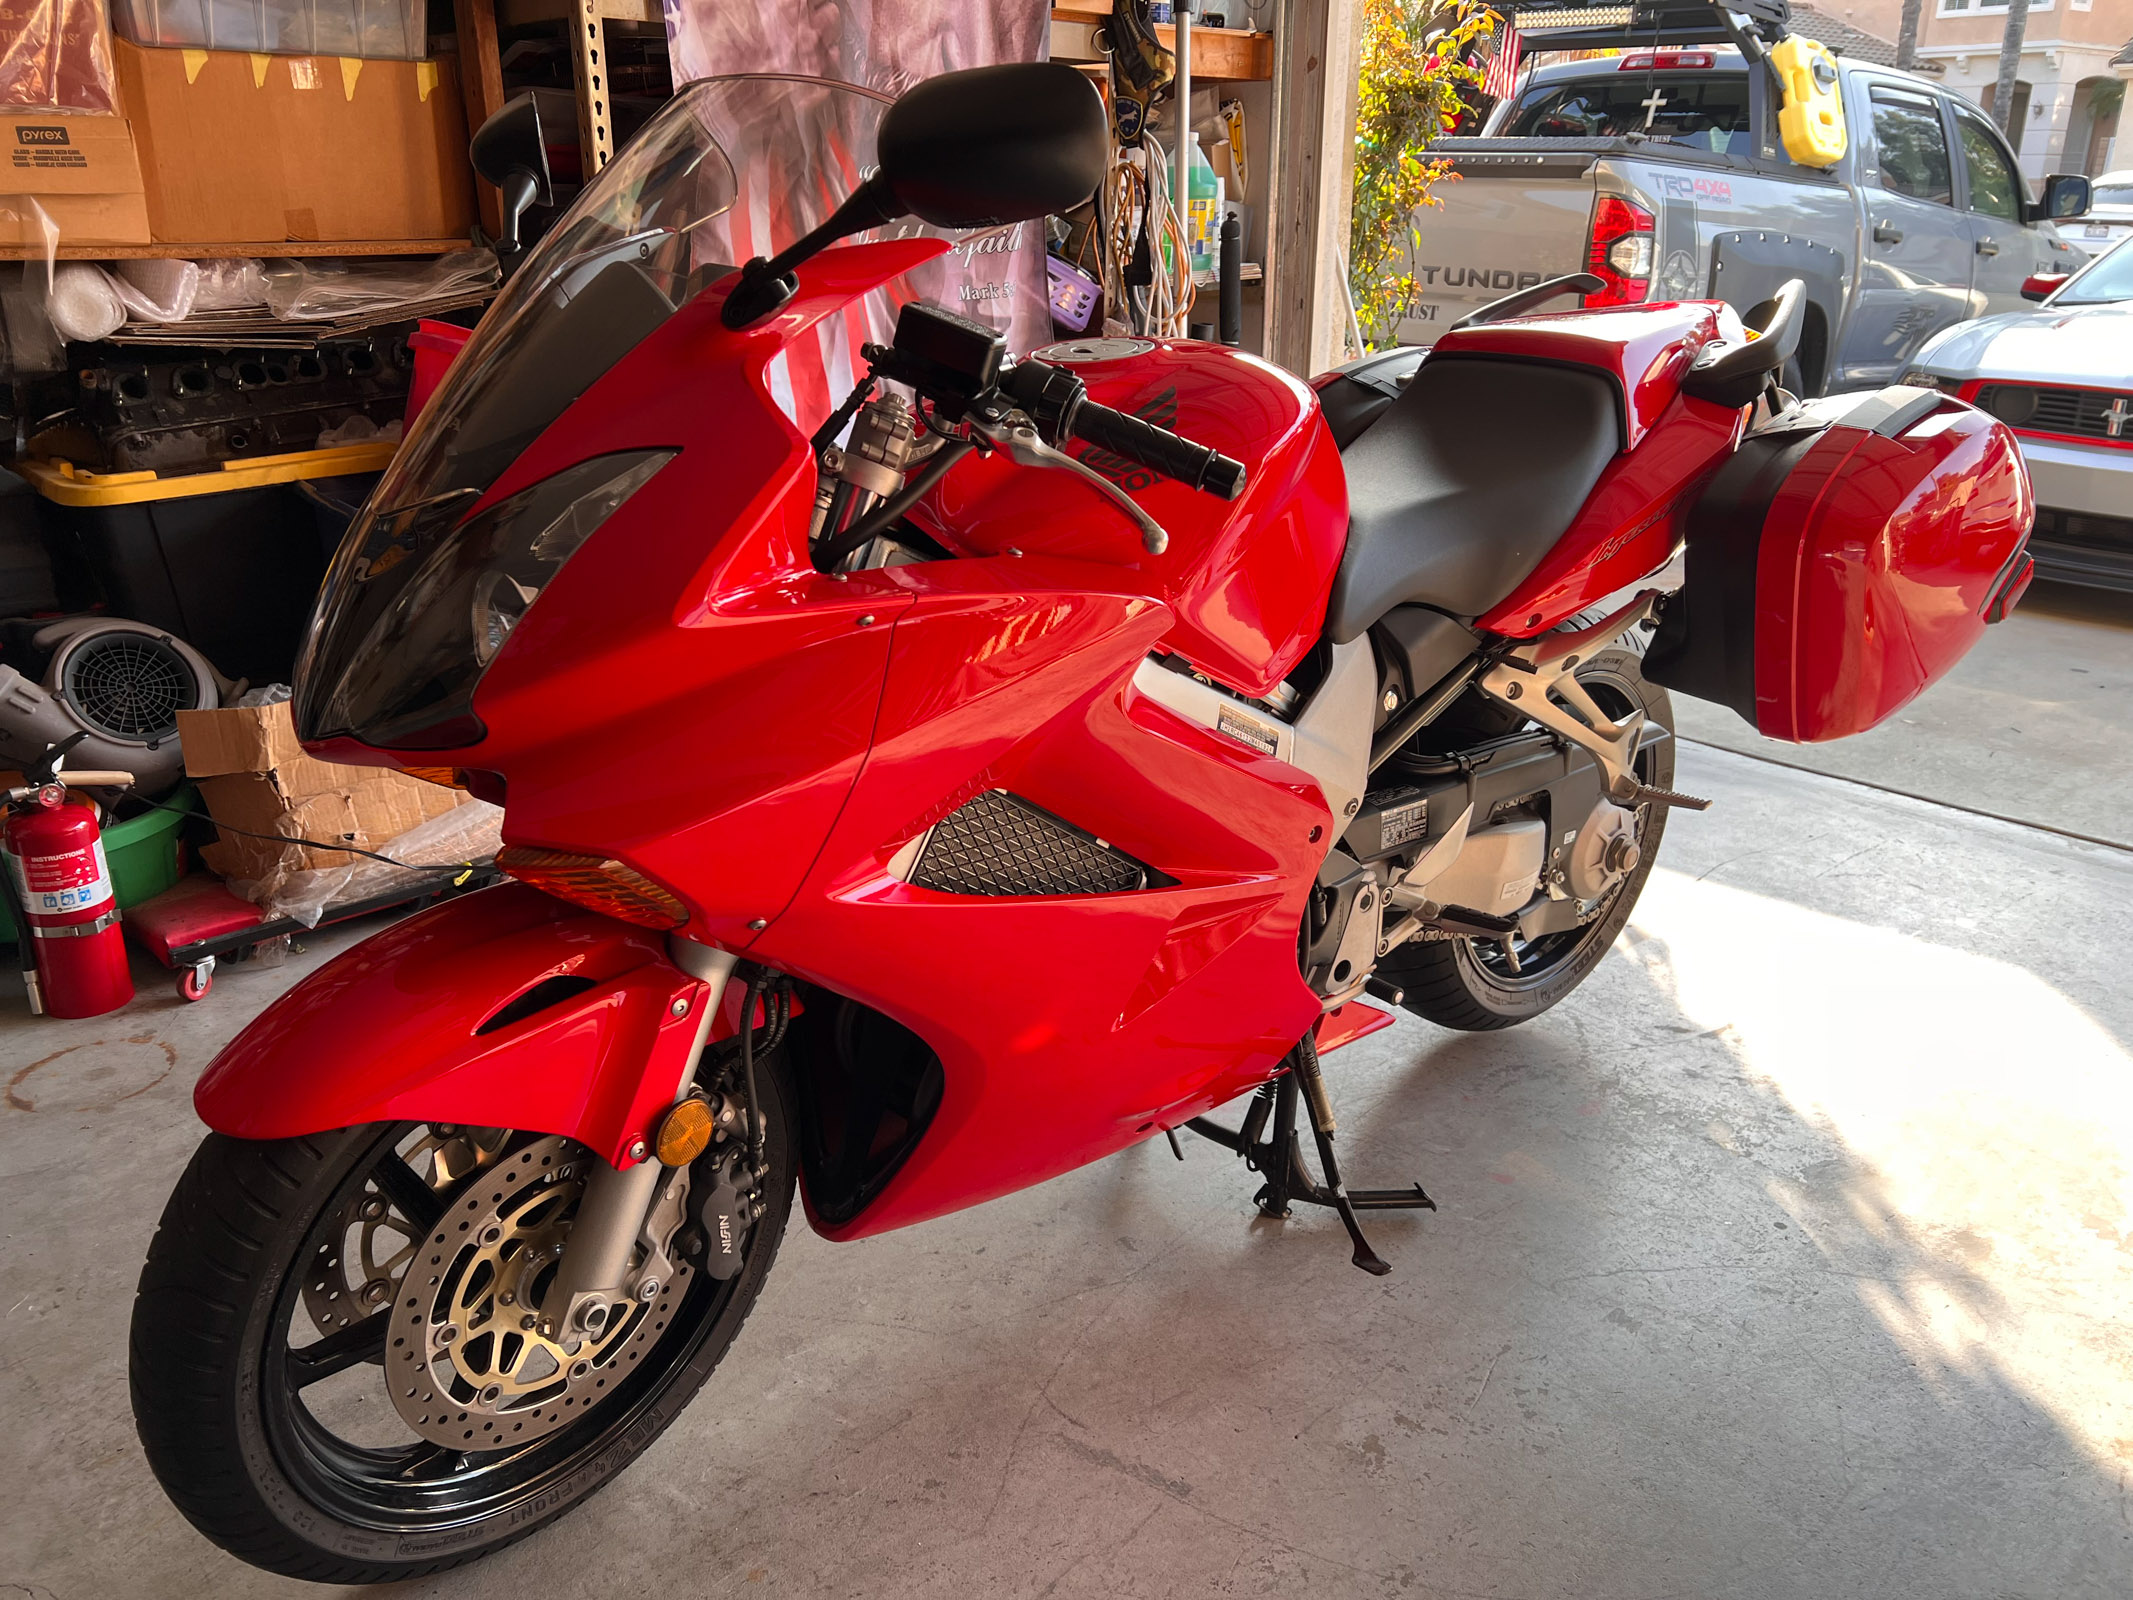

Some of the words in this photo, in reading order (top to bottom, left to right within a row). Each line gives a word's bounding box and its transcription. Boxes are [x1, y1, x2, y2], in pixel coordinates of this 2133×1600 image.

[22, 130, 63, 142] pyrex
[1648, 172, 1693, 197] TRD
[1421, 265, 1566, 290] TUNDR
[959, 284, 999, 301] Mark
[31, 848, 85, 862] INSTRUCTIONS
